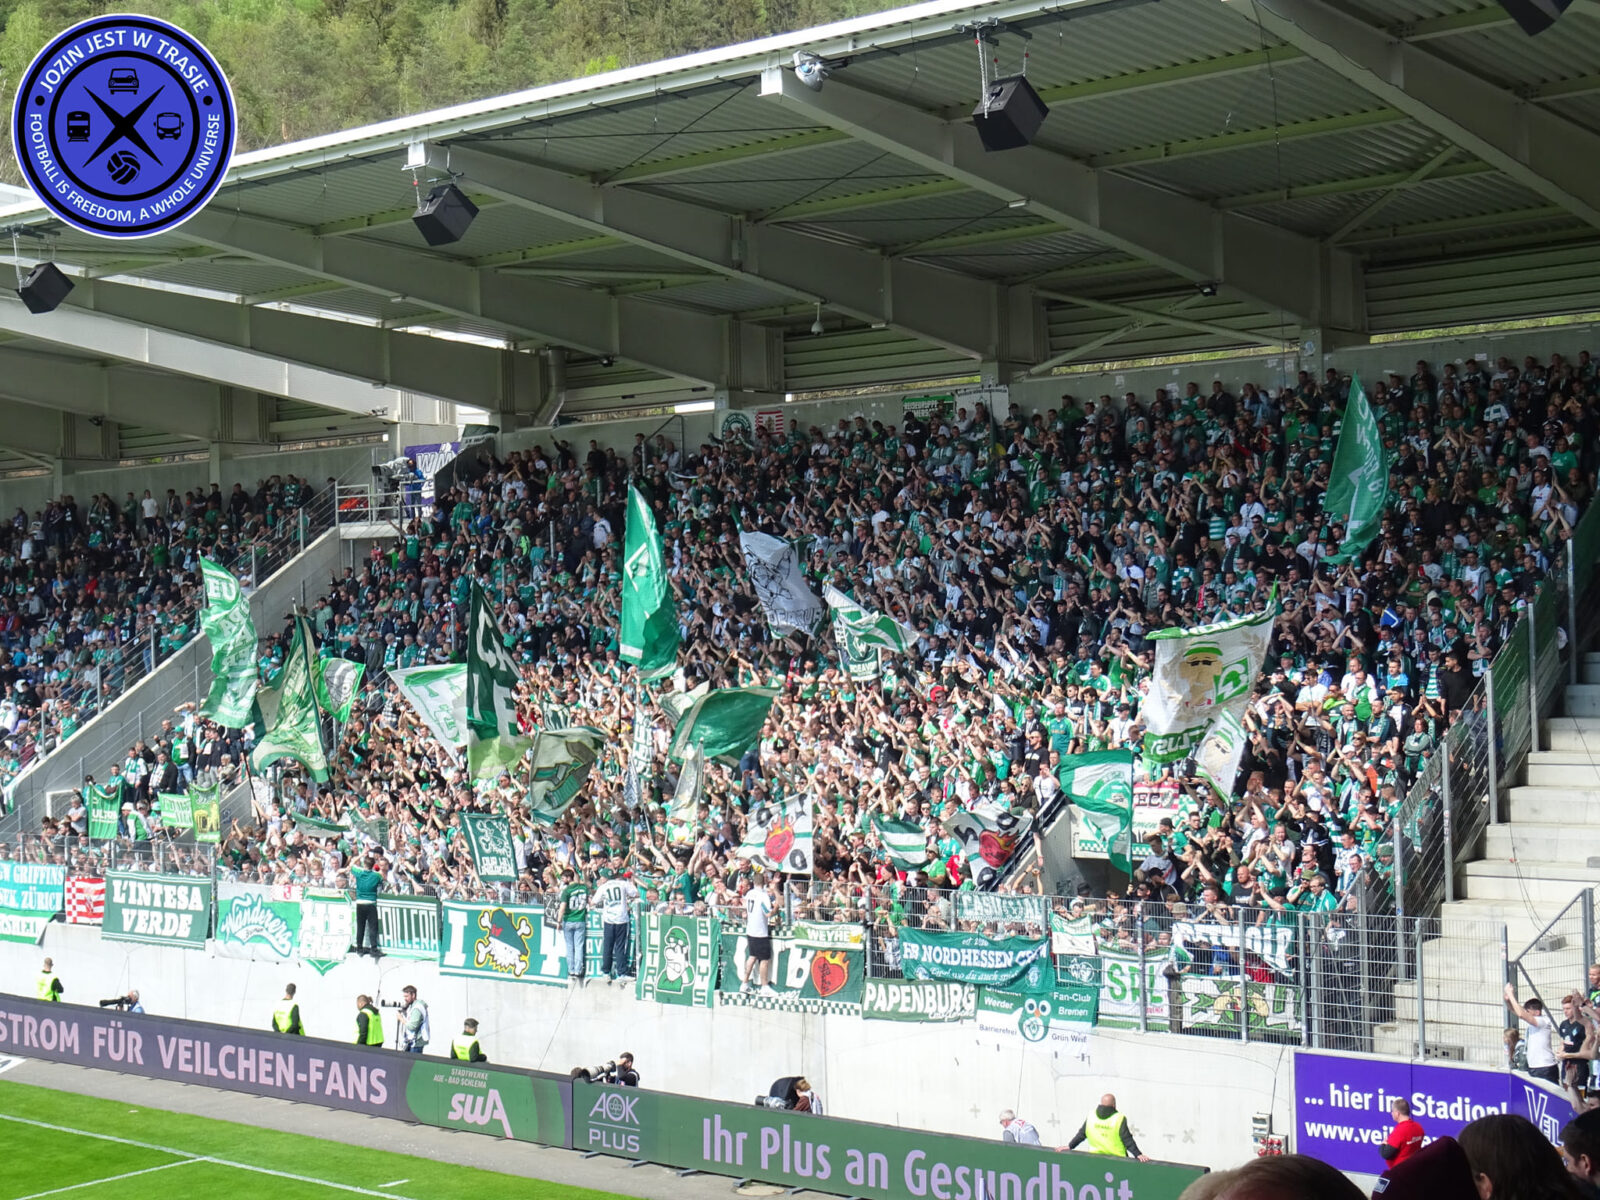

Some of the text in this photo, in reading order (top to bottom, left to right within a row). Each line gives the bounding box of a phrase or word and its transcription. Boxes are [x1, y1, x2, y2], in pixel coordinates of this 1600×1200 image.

[113, 879, 204, 912] L'INTESA
[606, 886, 622, 902] 10
[122, 908, 193, 938] VERDE
[807, 928, 850, 943] WEYHE
[642, 915, 660, 1001] ULTRA
[693, 919, 710, 1006] BOYS
[921, 944, 1014, 969] NORDHESSEN
[863, 981, 977, 1014] PAPENBURG
[984, 996, 1015, 1010] Werder
[1053, 991, 1092, 1003] Fan-Club
[1058, 1006, 1089, 1017] Bremen
[1051, 1033, 1069, 1044] Grün
[0, 1012, 389, 1106] STROM FÜR VEILCHEN-FANS
[433, 1074, 445, 1083] AUE
[447, 1076, 460, 1085] BAD
[460, 1078, 487, 1089] SCHLEMA
[451, 1068, 489, 1081] STADTWERKE
[588, 1091, 640, 1125] AOK
[1330, 1083, 1373, 1111] hier
[1411, 1092, 1508, 1123] Stadion!
[588, 1127, 640, 1153] PLUS
[703, 1114, 748, 1166] Ihr
[760, 1123, 832, 1180] Plus
[844, 1148, 889, 1189] an
